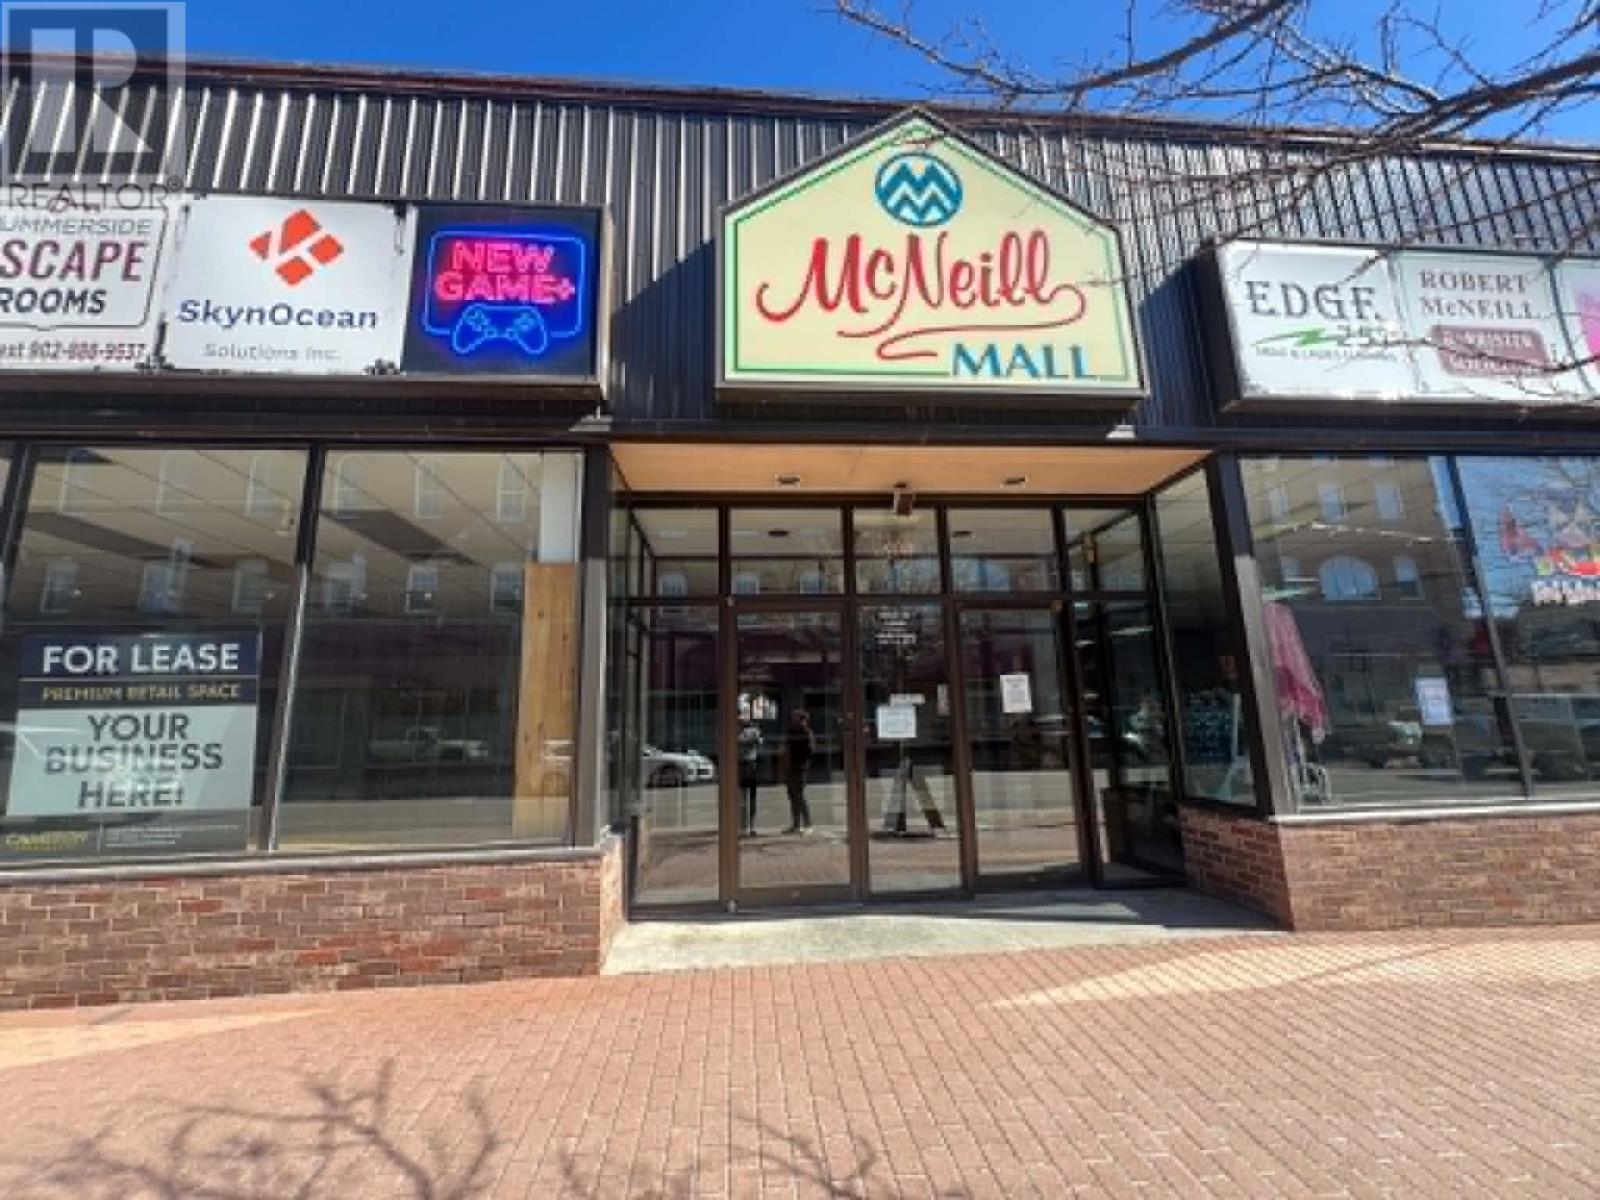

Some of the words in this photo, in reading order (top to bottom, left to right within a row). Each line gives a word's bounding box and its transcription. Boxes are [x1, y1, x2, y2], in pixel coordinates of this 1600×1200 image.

[452, 240, 554, 273] NEW
[756, 230, 1086, 340] McNeill
[1419, 269, 1533, 293] ROBERT
[176, 300, 377, 330] SkynOcean
[1246, 280, 1383, 320] EDGE
[951, 342, 1101, 379] MALL
[43, 645, 119, 674] FOR
[130, 643, 240, 673] LEASE
[87, 713, 189, 742] YOUR
[45, 743, 223, 774] BUSINESS
[77, 779, 184, 808] HERE!
